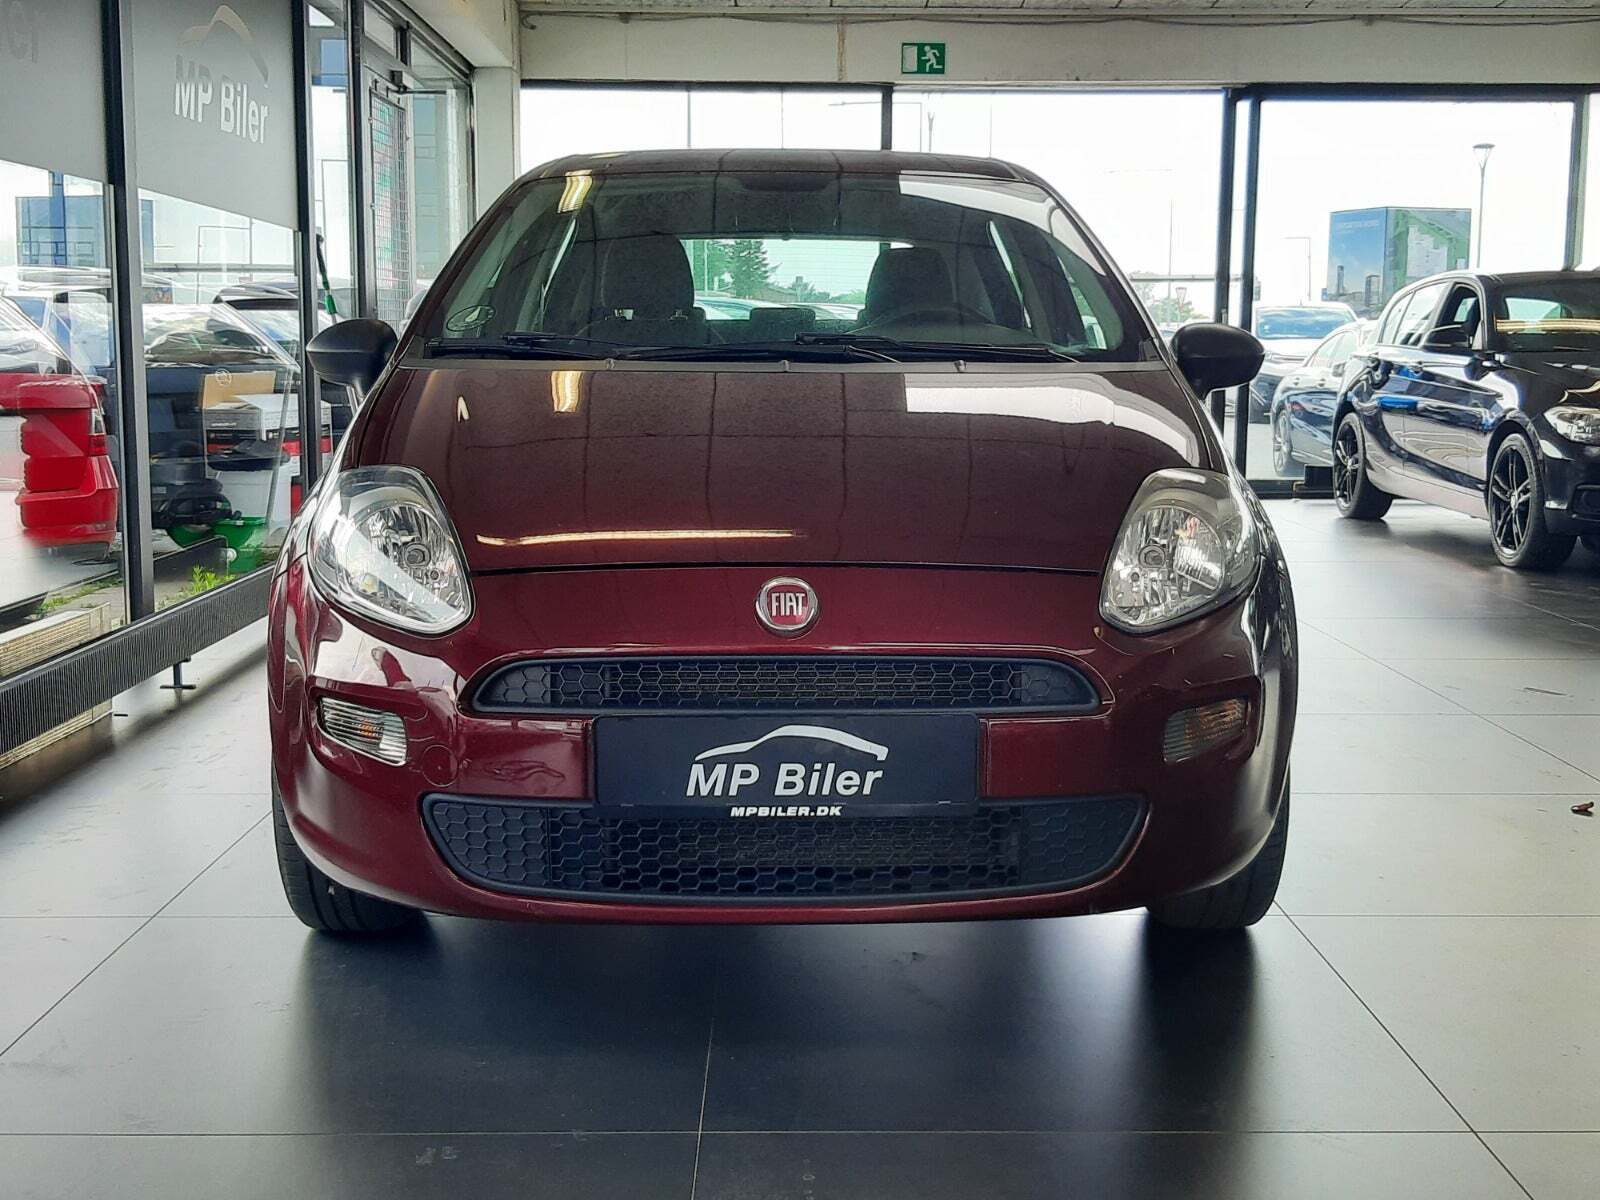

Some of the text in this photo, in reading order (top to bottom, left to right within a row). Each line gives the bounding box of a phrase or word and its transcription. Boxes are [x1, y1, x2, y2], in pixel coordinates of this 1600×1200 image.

[175, 55, 269, 144] MP Biler
[771, 592, 805, 617] FIAT
[686, 762, 884, 797] MP Biler
[730, 806, 843, 817] MPBILER.DK
